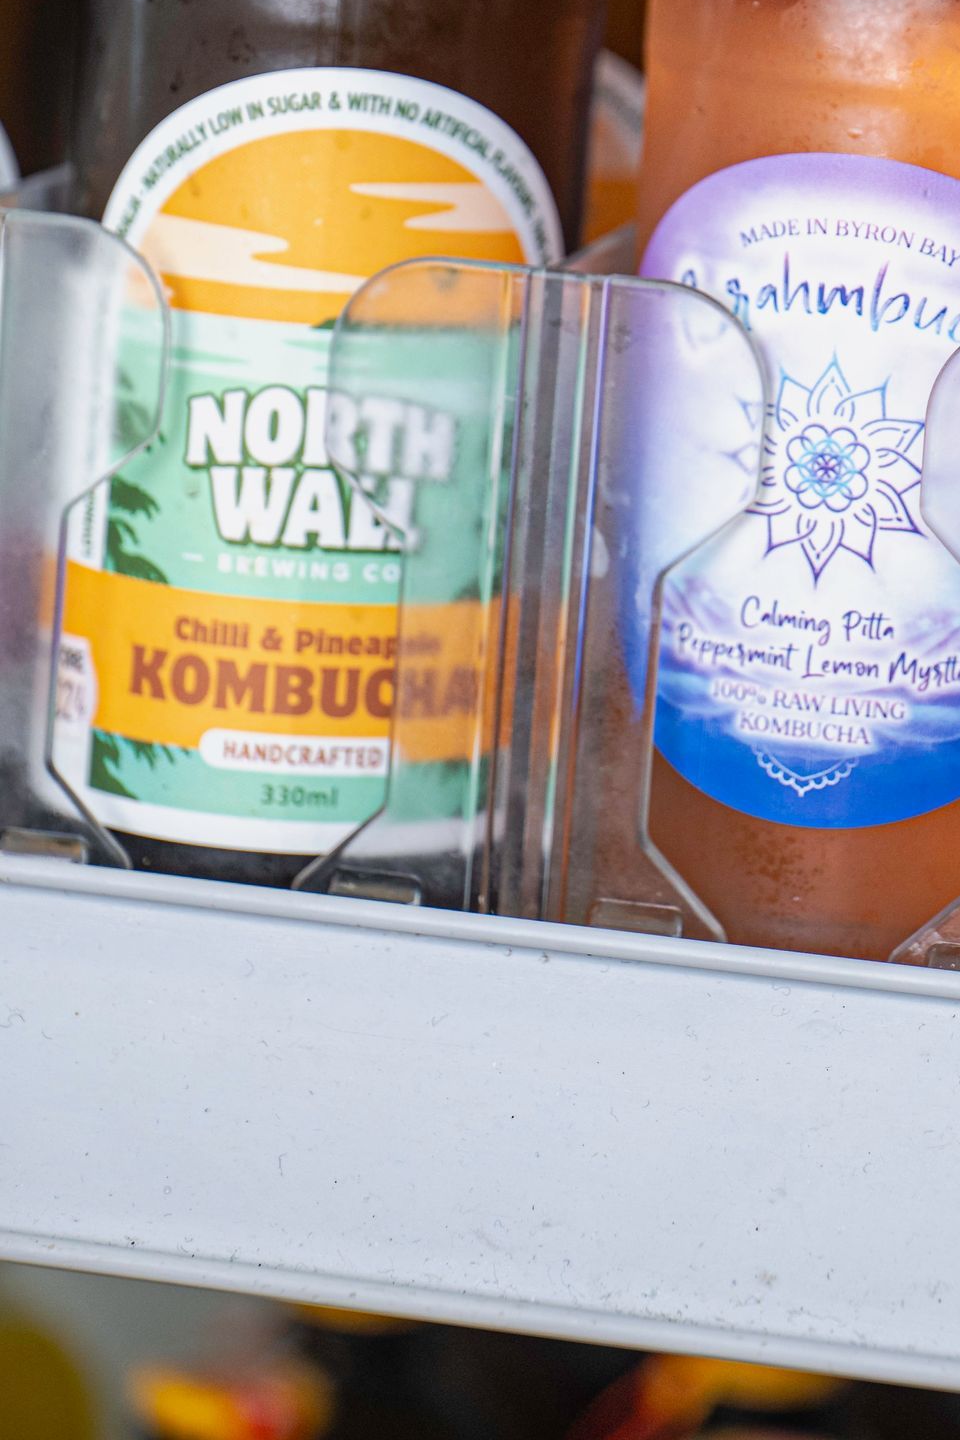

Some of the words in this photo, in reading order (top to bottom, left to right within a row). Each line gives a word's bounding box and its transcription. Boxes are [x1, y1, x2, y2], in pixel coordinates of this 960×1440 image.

[207, 106, 243, 135] LOW
[246, 101, 265, 120] IN
[266, 91, 322, 116] SUGAR
[328, 91, 341, 111] &
[347, 91, 392, 116] WITH
[394, 98, 421, 121] NO
[421, 108, 492, 159] ARTIFICIAL
[739, 219, 800, 248] MADE
[806, 217, 828, 236] IN
[836, 219, 914, 249] BYRON
[183, 383, 457, 479] NORTH
[208, 465, 423, 553] WALL
[217, 553, 351, 582] BREWING
[174, 615, 249, 651] Chilli
[260, 626, 283, 653] &
[740, 594, 831, 646] Calming
[841, 609, 895, 641] Pitta
[677, 621, 800, 673] Peppermint
[800, 644, 880, 679] Lemon
[128, 644, 480, 720] KOMBUCHA
[711, 680, 768, 706] 100%
[772, 688, 828, 712] RAW
[830, 695, 906, 721] LIVING
[738, 711, 871, 745] KOMBUCHA
[222, 740, 384, 769] HANDCRAFTED
[260, 782, 339, 808] 330ml
